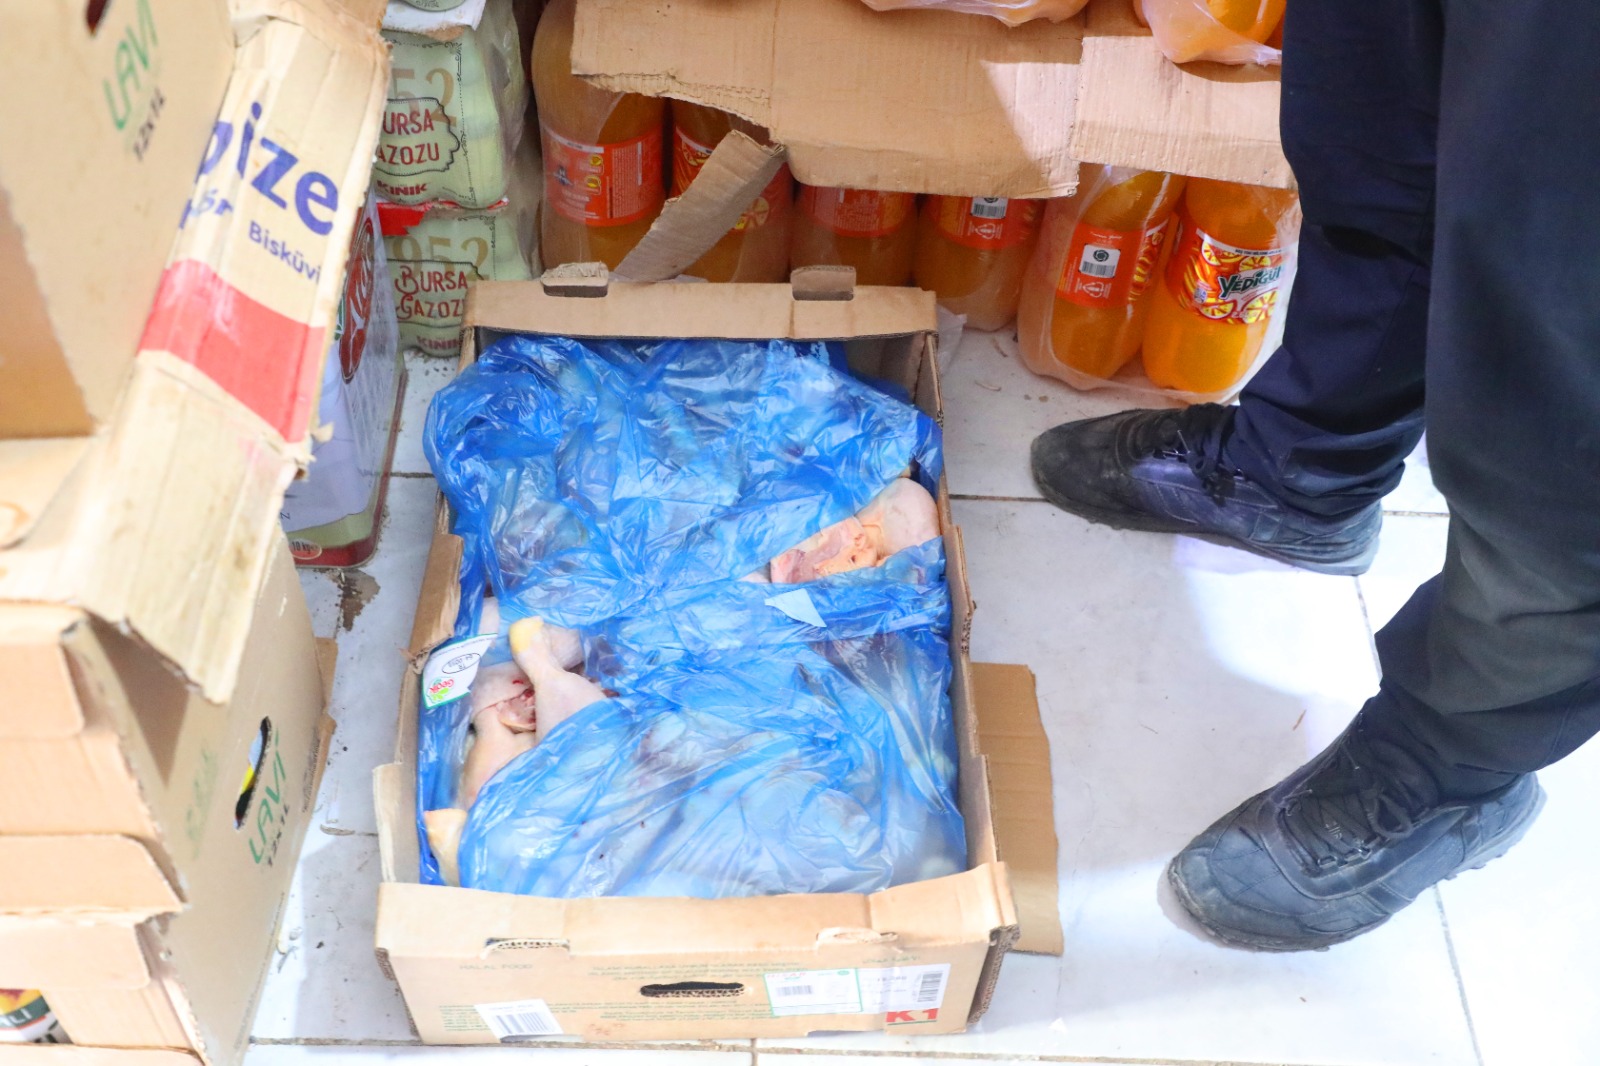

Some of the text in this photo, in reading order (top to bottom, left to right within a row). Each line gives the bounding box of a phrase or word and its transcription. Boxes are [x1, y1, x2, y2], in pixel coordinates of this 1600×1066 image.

[382, 108, 435, 136] URSA
[376, 142, 441, 166] AZOZU
[392, 236, 491, 282] 952
[394, 264, 468, 295] BURSA
[395, 293, 464, 320] GAZOZ
